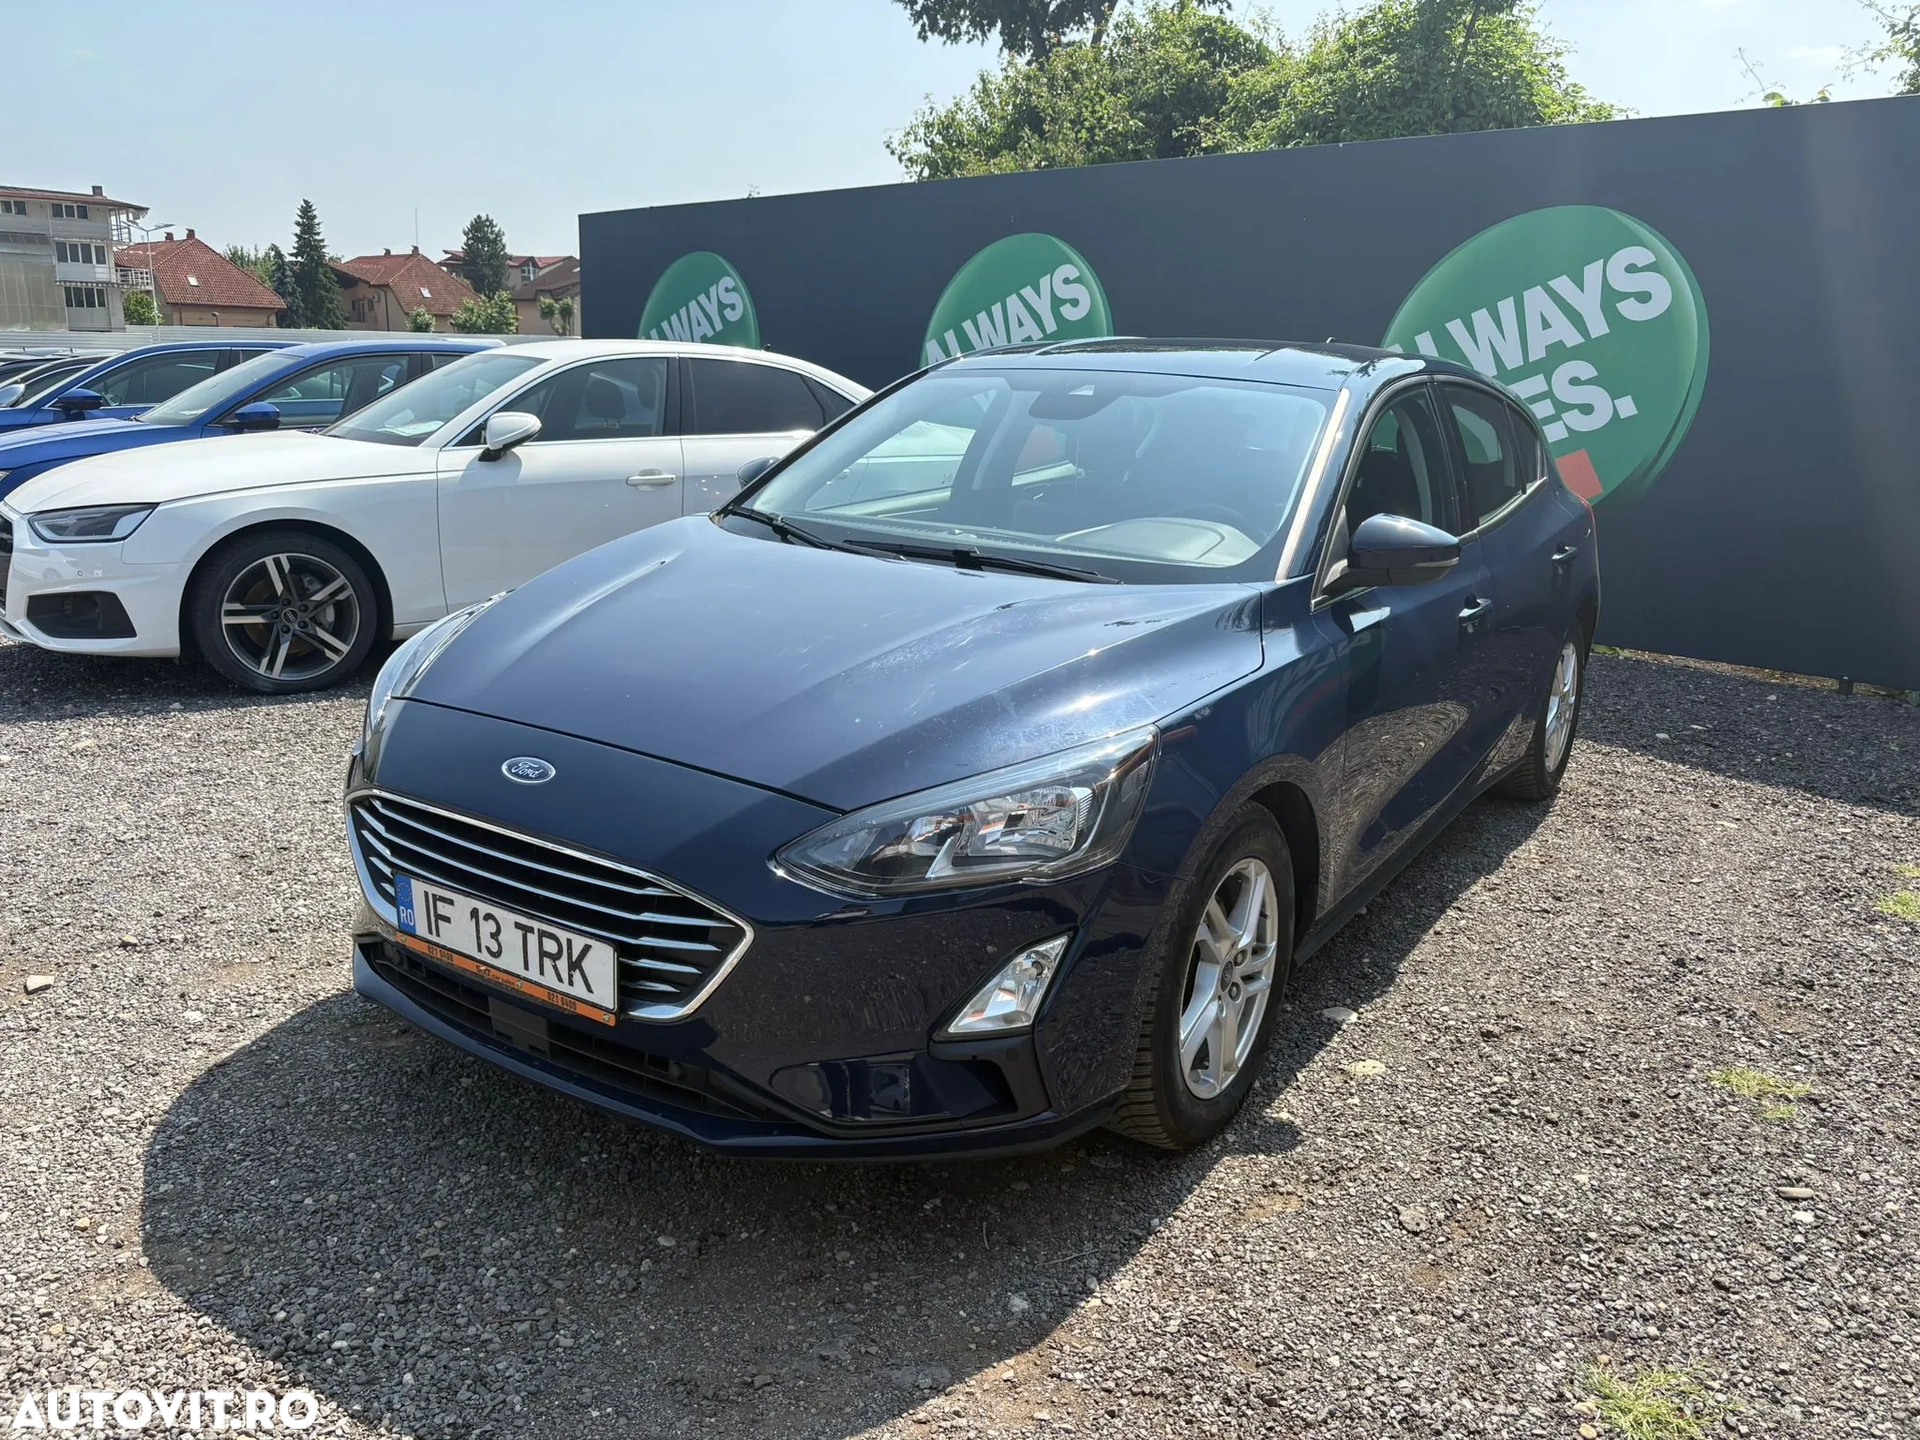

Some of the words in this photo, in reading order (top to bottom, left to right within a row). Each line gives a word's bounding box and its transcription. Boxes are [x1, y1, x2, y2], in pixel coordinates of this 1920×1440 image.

[641, 276, 743, 342] WAYS
[1386, 246, 1672, 377] WAYS
[511, 761, 543, 778] Ford
[399, 906, 414, 926] RO
[424, 890, 455, 938] IF
[470, 907, 503, 959] 13
[514, 921, 594, 994] TRK
[547, 991, 560, 1005] 021
[561, 997, 577, 1011] 9400
